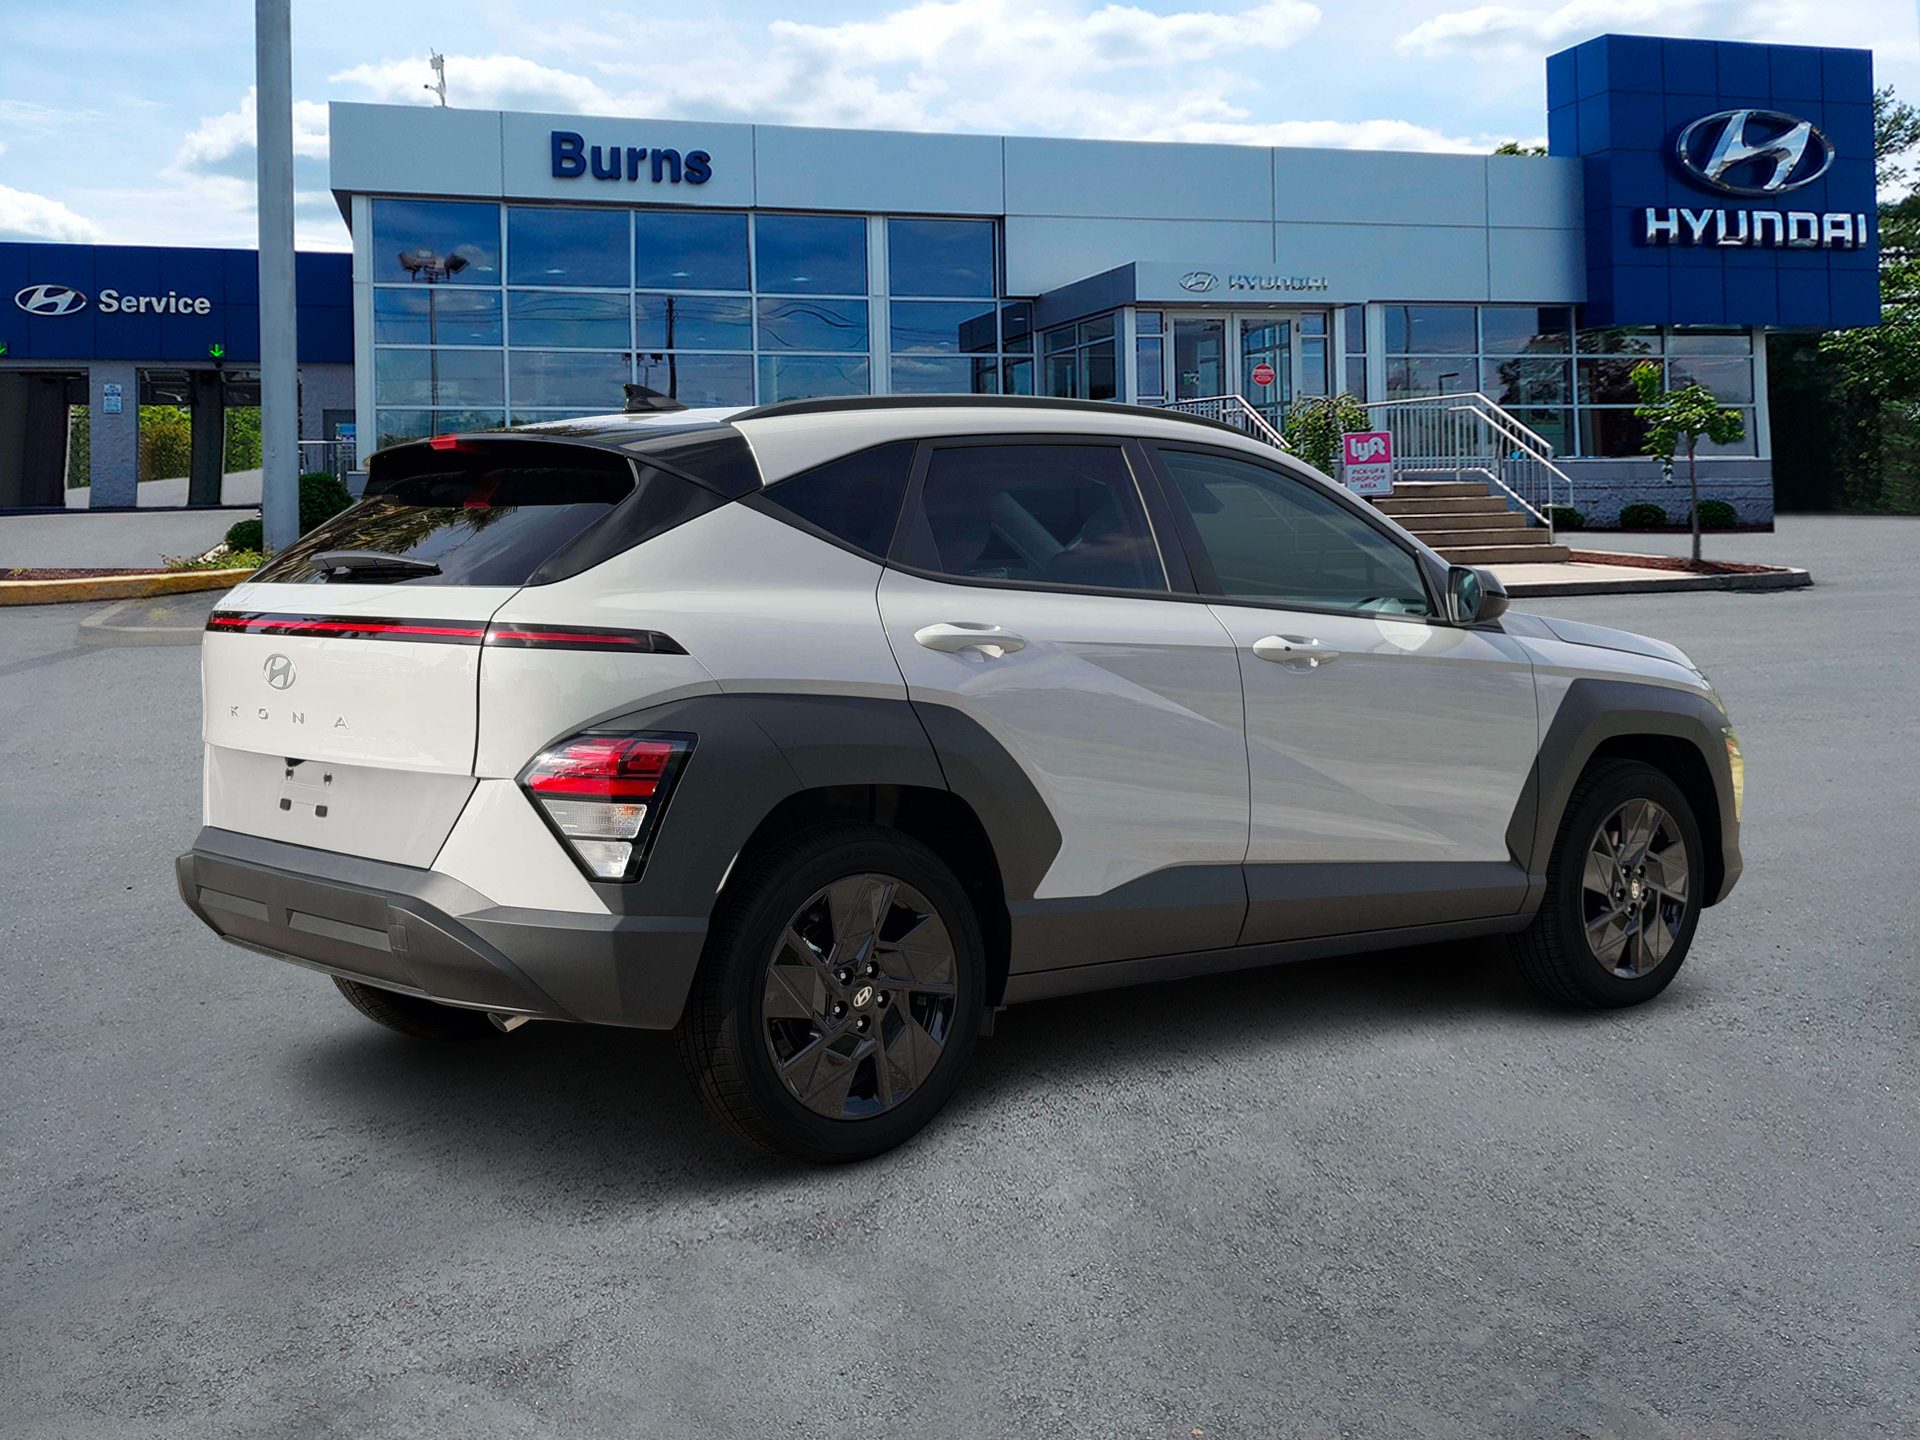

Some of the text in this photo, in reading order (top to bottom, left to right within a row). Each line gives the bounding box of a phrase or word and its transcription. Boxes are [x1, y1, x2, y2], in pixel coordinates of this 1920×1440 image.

[550, 130, 713, 185] Burns
[1645, 207, 1868, 249] HYUNDAI
[1228, 274, 1329, 291] HYUNDAI
[98, 288, 212, 315] Service
[1350, 436, 1386, 462] lyft
[1351, 474, 1386, 482] DROP-OFF
[230, 705, 350, 730] KONA
